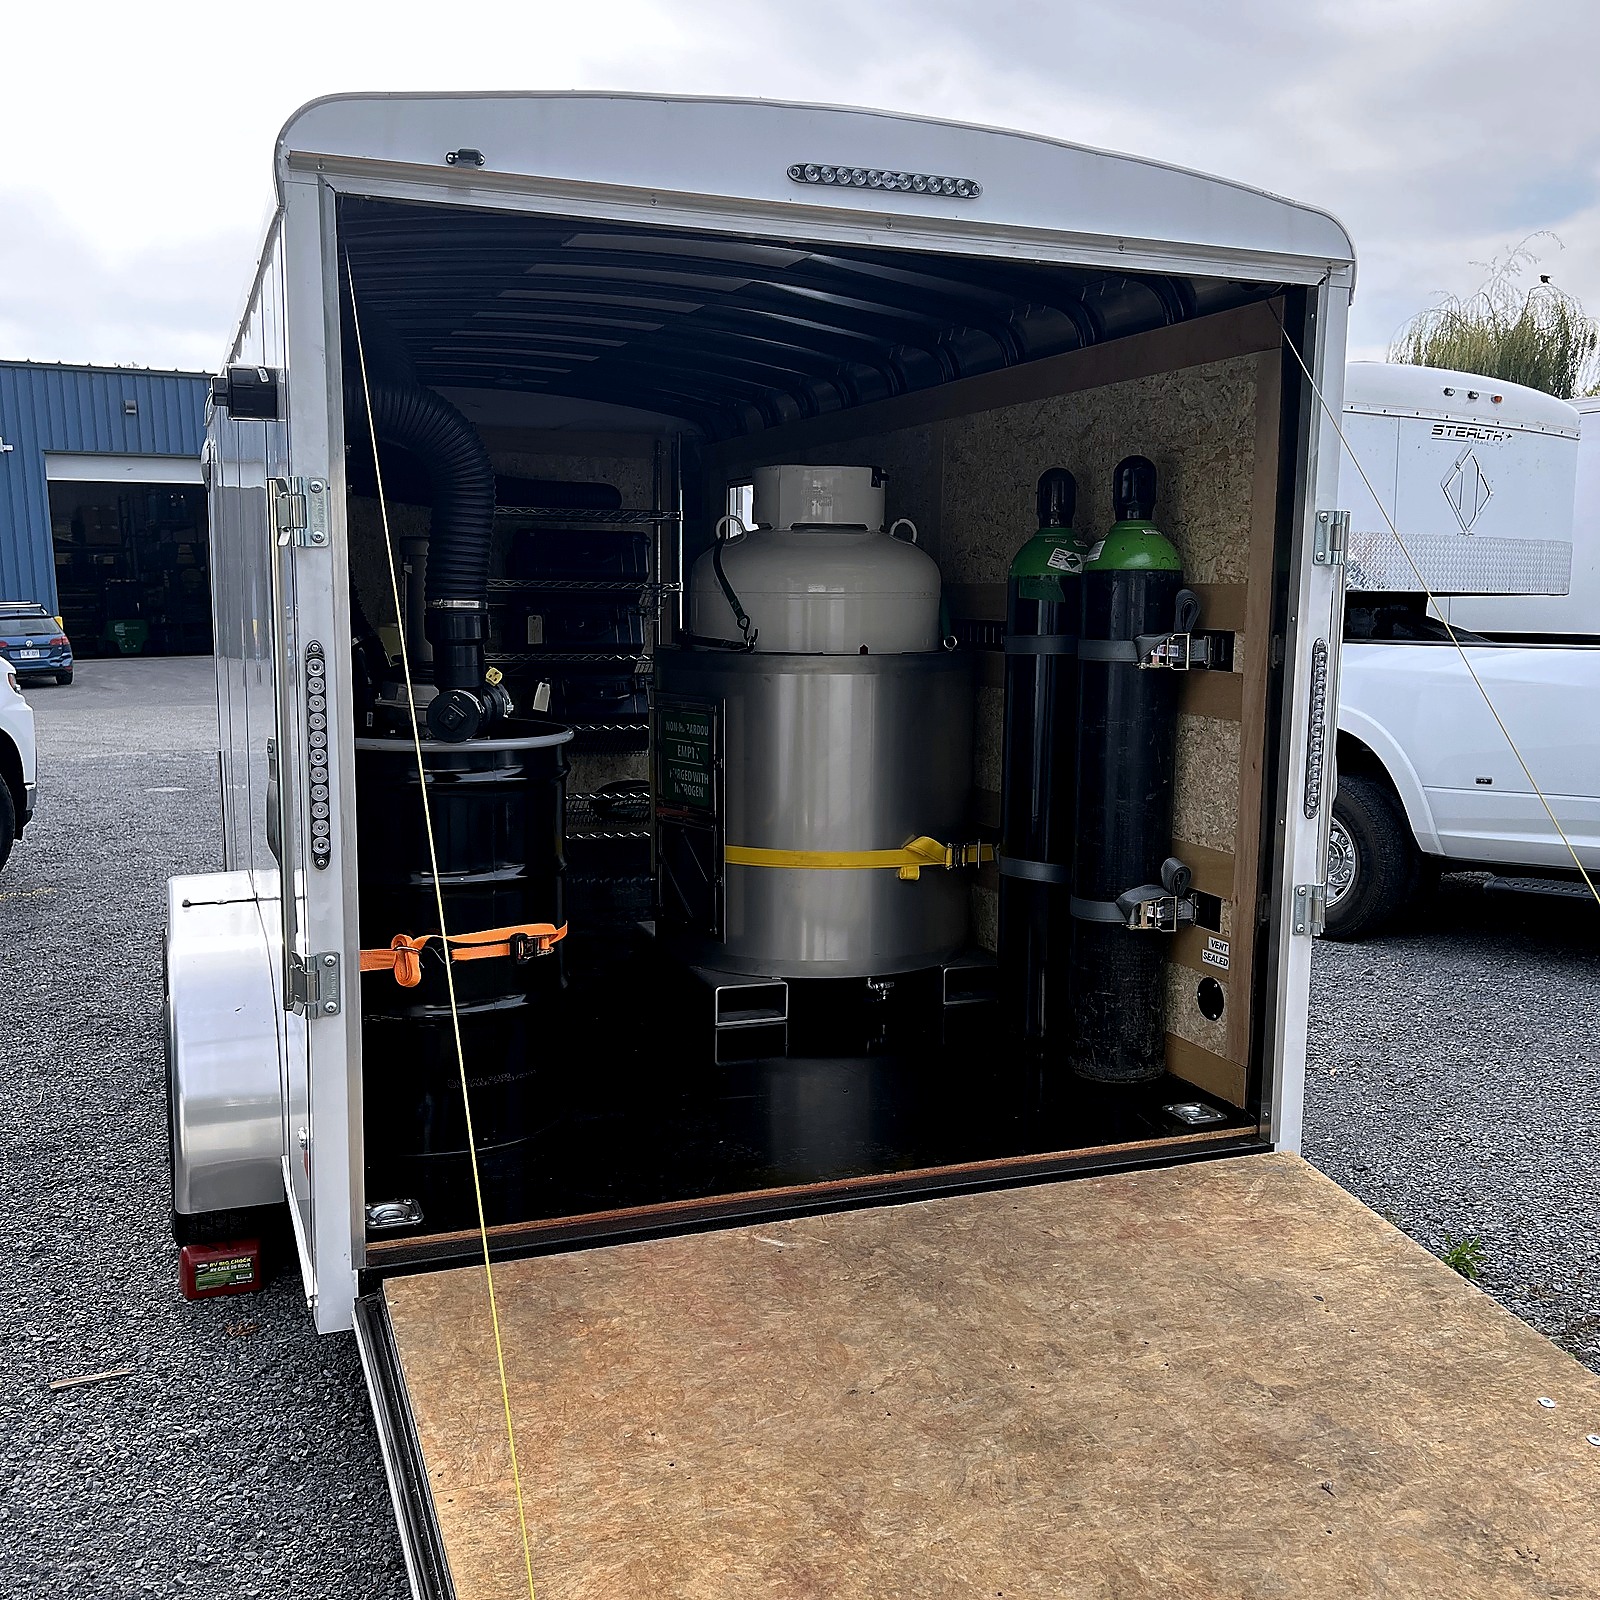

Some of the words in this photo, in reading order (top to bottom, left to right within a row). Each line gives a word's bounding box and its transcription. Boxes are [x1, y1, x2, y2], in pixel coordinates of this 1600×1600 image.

[1431, 425, 1505, 441] STEALTH
[692, 770, 709, 785] WITH
[675, 782, 704, 797] NTROGEN
[1211, 940, 1228, 951] VENT
[1203, 952, 1228, 966] SEALED
[230, 1257, 251, 1265] CHOCK
